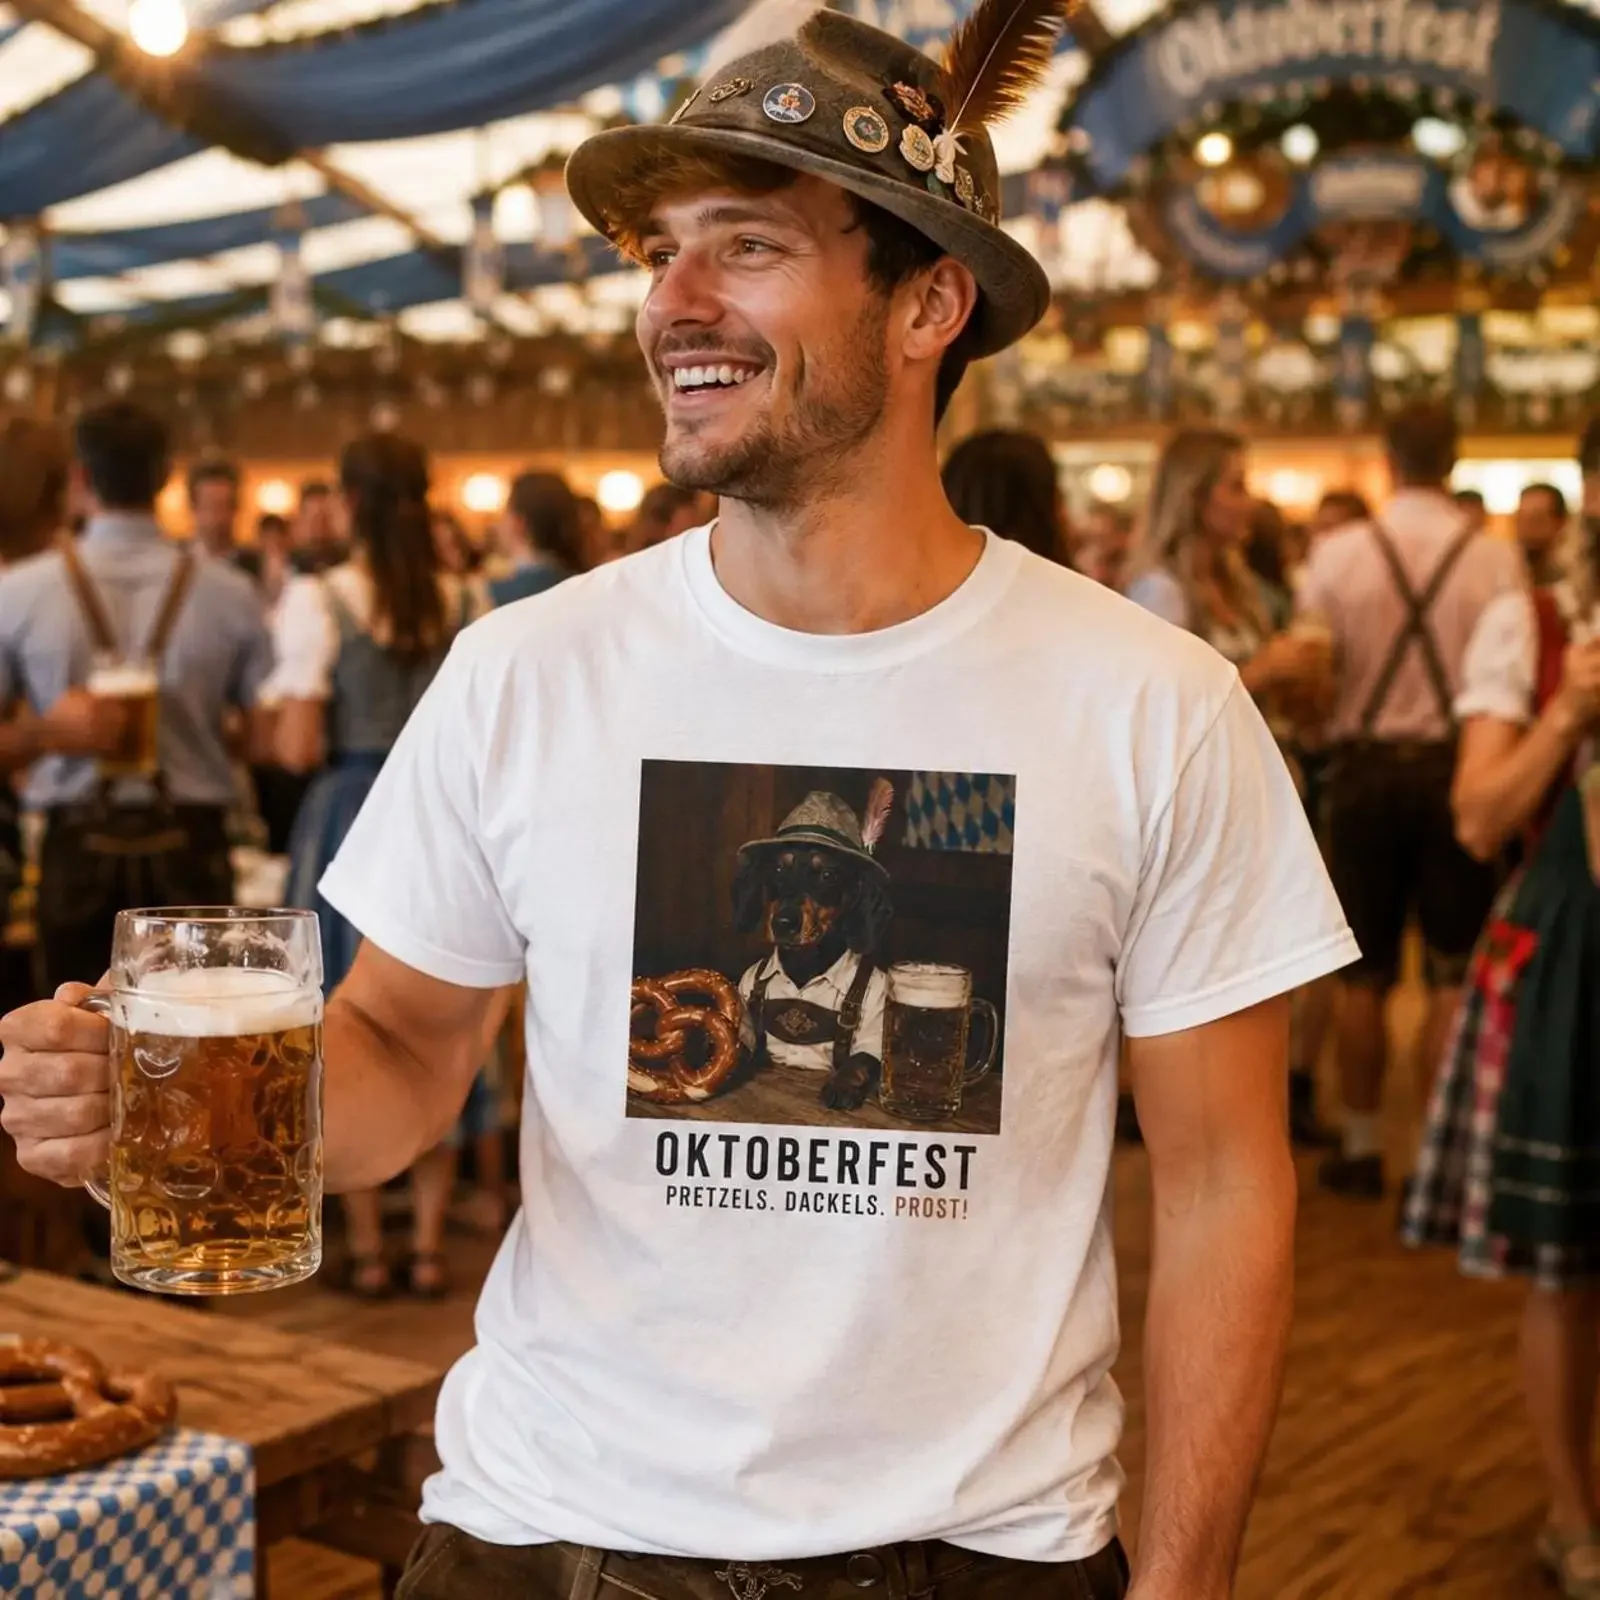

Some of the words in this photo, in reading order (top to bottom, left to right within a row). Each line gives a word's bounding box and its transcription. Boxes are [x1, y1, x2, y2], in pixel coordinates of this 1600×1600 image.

[655, 1130, 978, 1191] OKTOBERFEST
[665, 1184, 775, 1211] PRETZELS.
[784, 1190, 885, 1216] DACKELS.
[895, 1195, 968, 1220] PROST!
